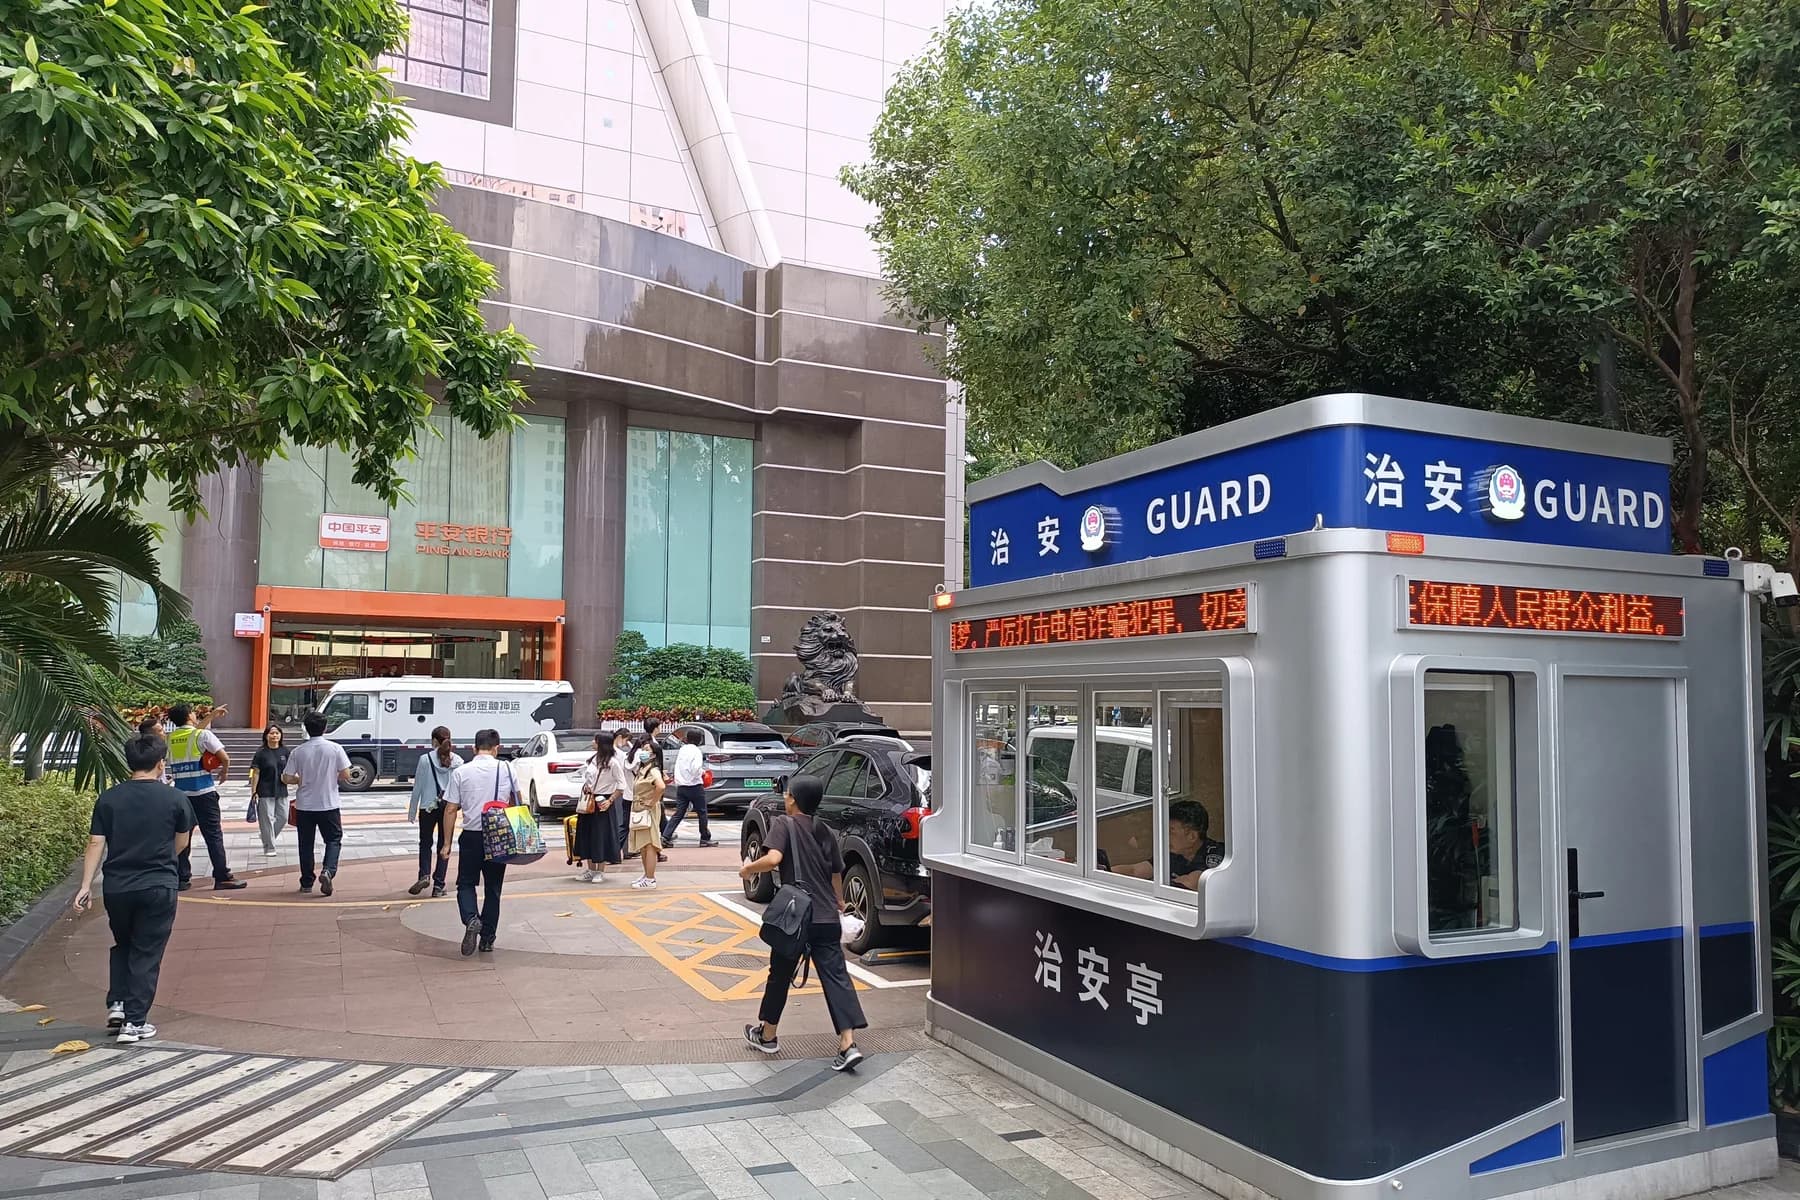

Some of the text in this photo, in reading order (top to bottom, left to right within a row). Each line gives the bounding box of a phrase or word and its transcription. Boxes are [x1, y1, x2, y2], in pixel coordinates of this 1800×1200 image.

[1146, 473, 1271, 535] GUARD
[1363, 452, 1463, 514] 治安
[1534, 479, 1664, 529] GUARD
[328, 521, 382, 535] 中国平安
[415, 521, 512, 546] 平安银行
[475, 547, 510, 559] BANK
[990, 515, 1060, 566] 治安
[1409, 581, 1664, 635] 保障人民群众利益。
[1034, 929, 1163, 1025] 治安亭
